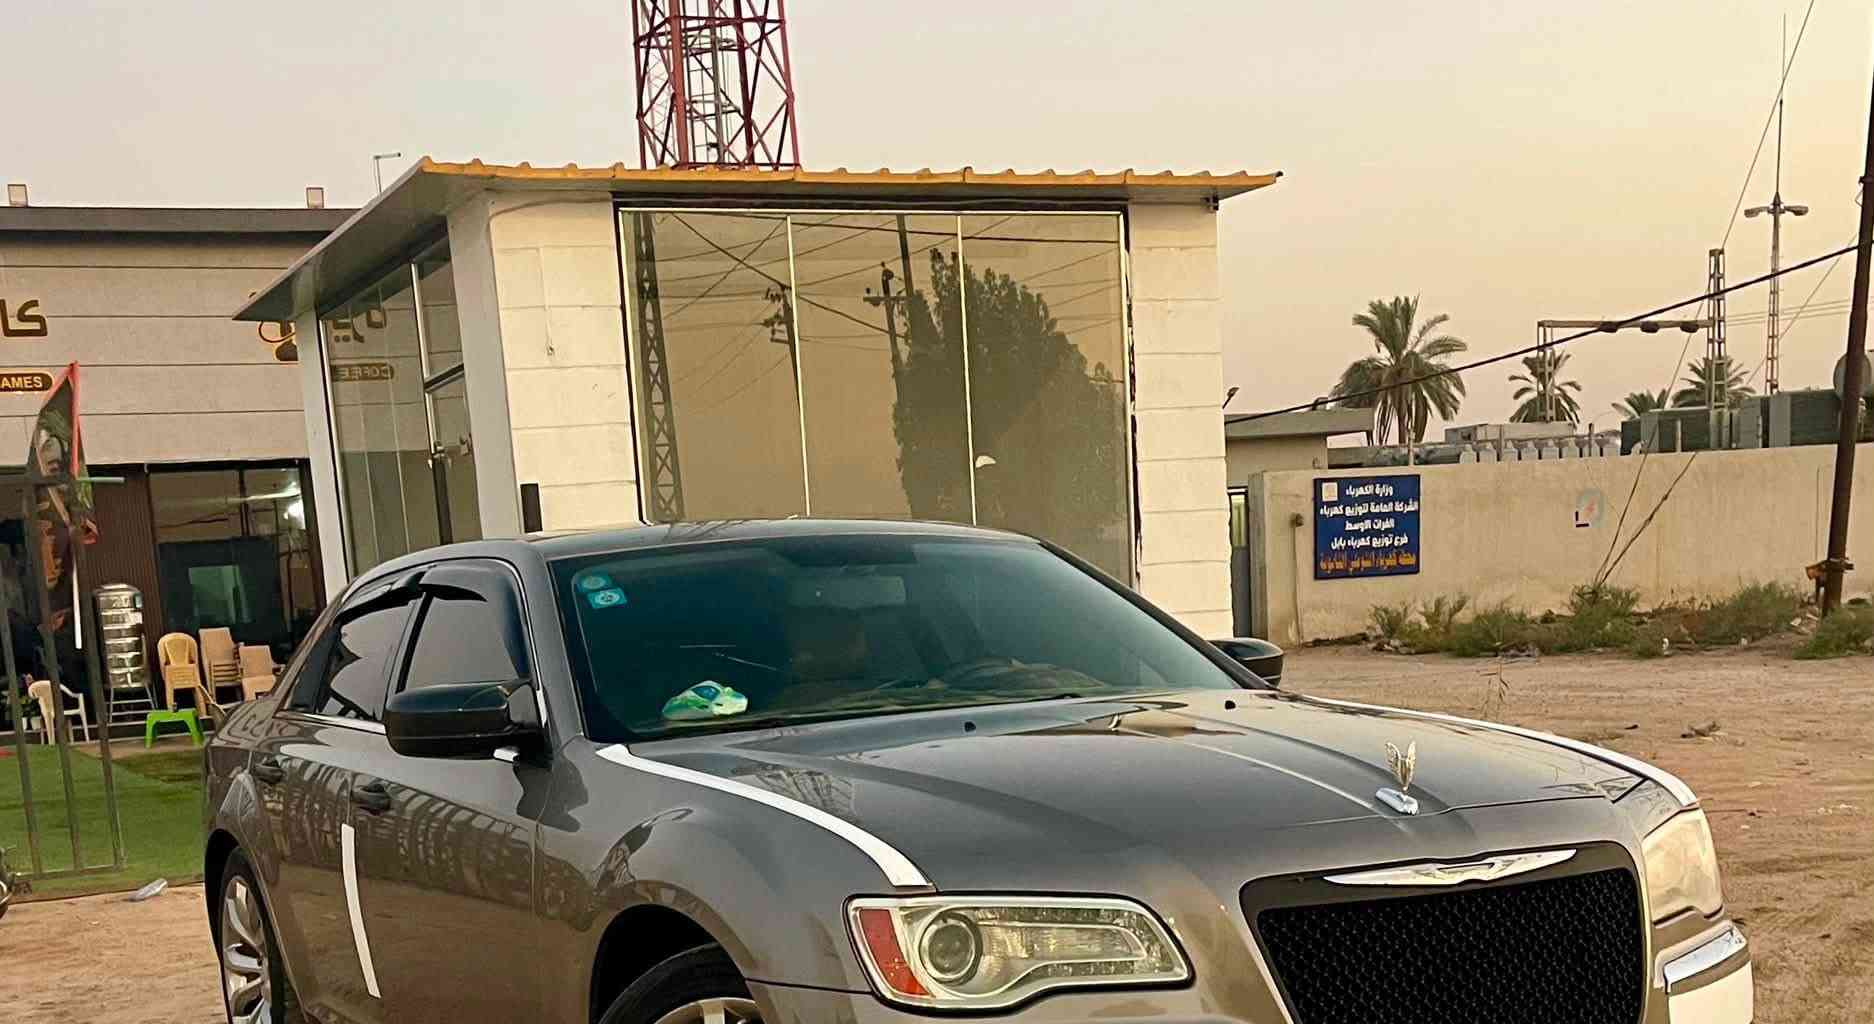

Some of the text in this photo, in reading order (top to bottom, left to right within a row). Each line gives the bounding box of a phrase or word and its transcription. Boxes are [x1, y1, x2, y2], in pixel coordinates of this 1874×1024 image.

[0, 376, 43, 389] AMES
[1345, 484, 1394, 497] وزارة الكهرباء
[1320, 505, 1344, 518] كهرباء
[1370, 501, 1393, 513] العامة
[1394, 498, 1419, 513] الشركة
[1373, 518, 1395, 531] الفرات
[1331, 532, 1409, 550] فرع توزيع كهرباء بابل
